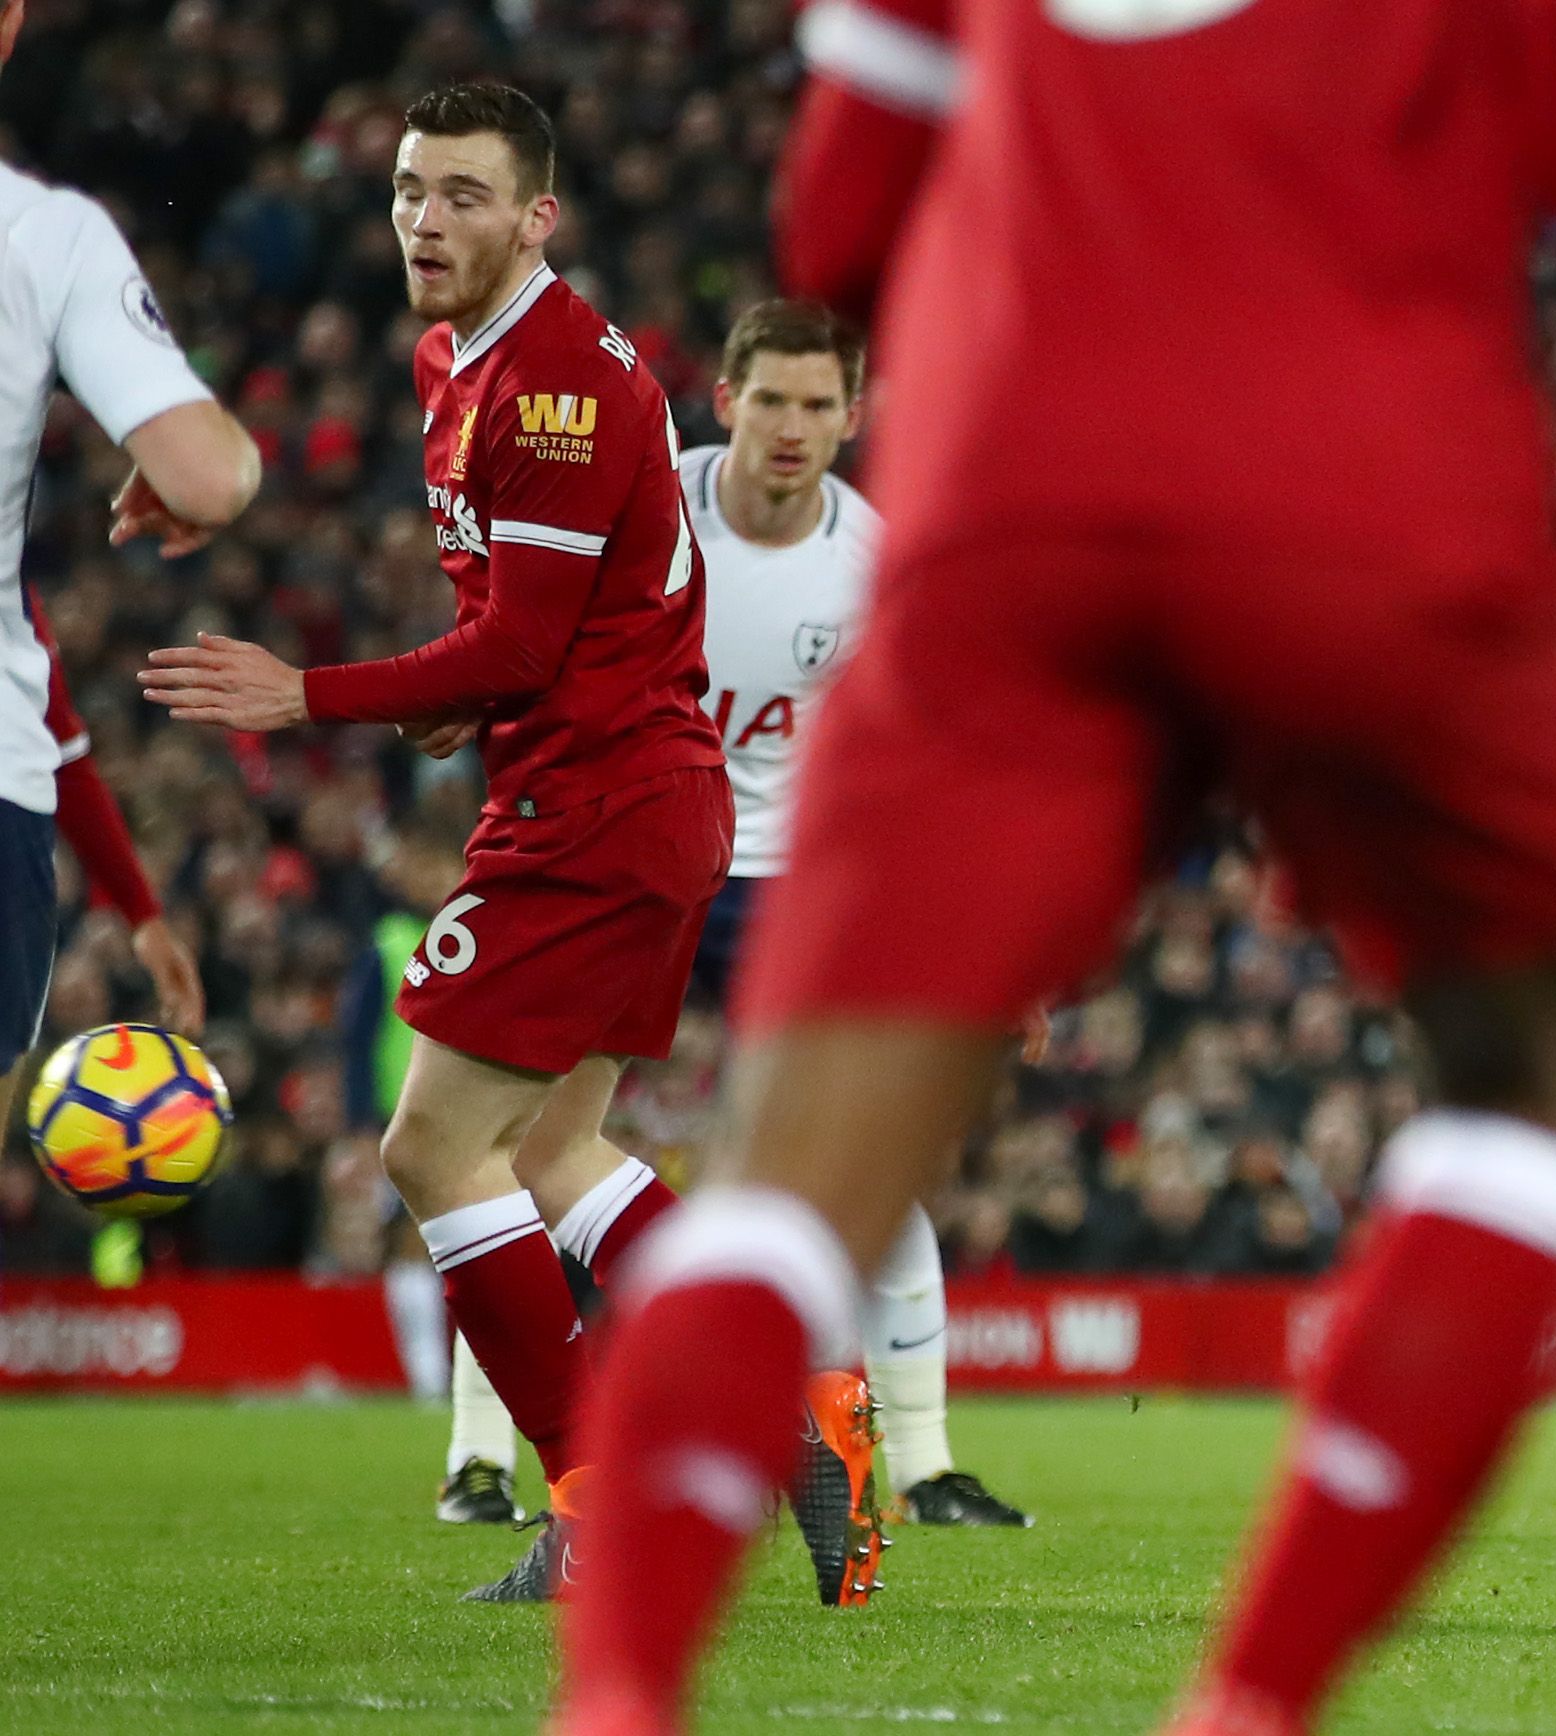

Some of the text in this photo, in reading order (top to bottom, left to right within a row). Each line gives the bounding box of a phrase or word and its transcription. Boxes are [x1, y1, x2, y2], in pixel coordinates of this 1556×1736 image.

[516, 393, 598, 436] WU
[514, 435, 594, 452] WESTERN
[535, 448, 592, 464] UNION
[425, 893, 486, 975] 6
